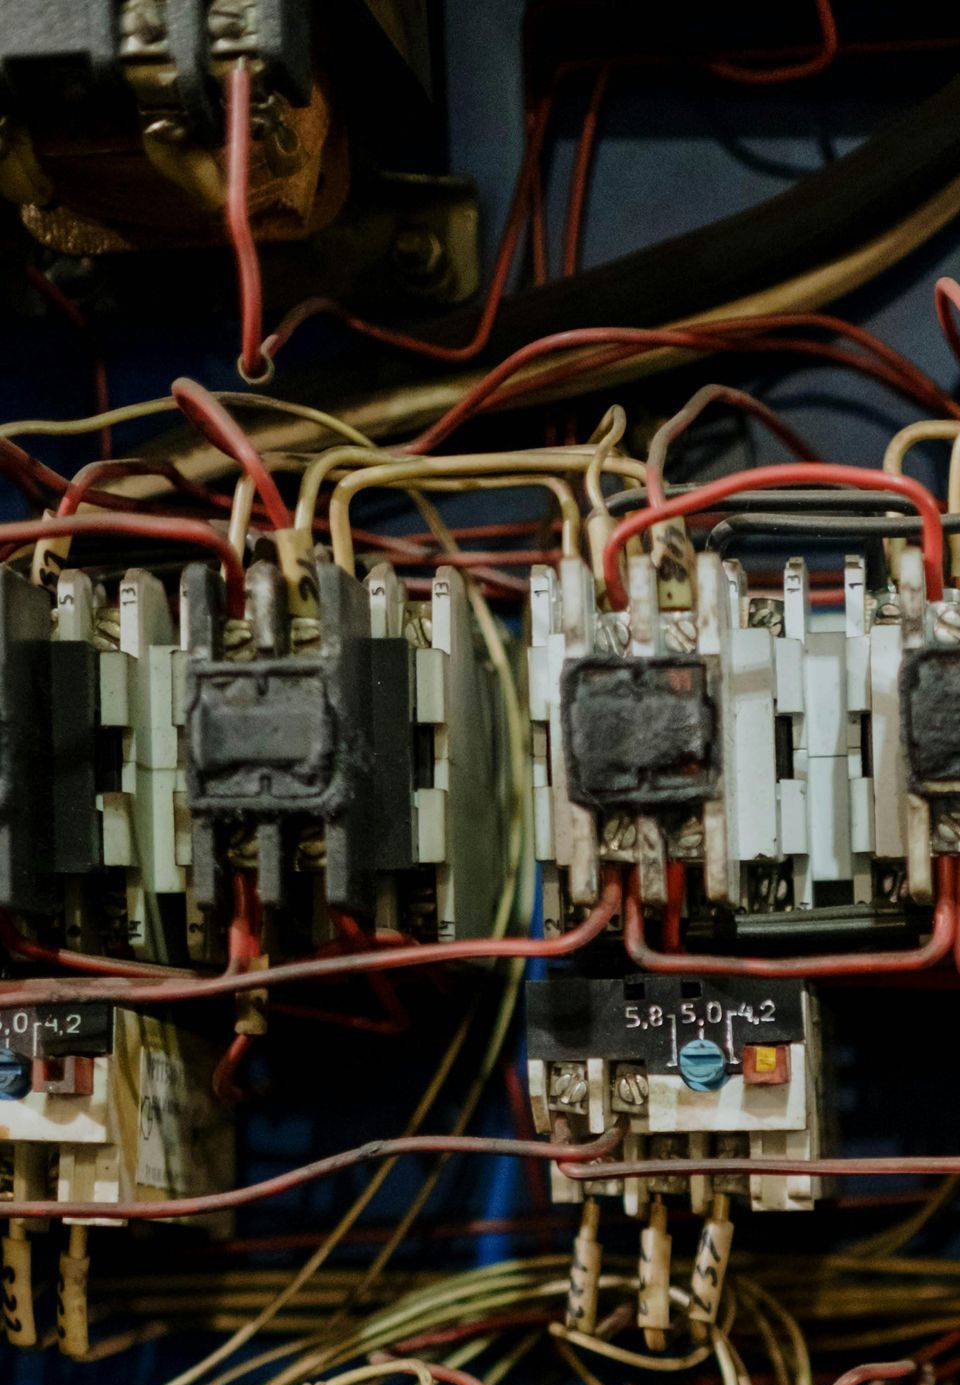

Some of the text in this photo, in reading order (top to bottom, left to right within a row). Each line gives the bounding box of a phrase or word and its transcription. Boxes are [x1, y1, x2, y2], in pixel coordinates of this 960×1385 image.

[121, 586, 137, 607] 13
[434, 581, 450, 598] 13
[0, 1012, 82, 1037] ,0 4,2
[624, 999, 776, 1030] 5,8 5,0 4,2
